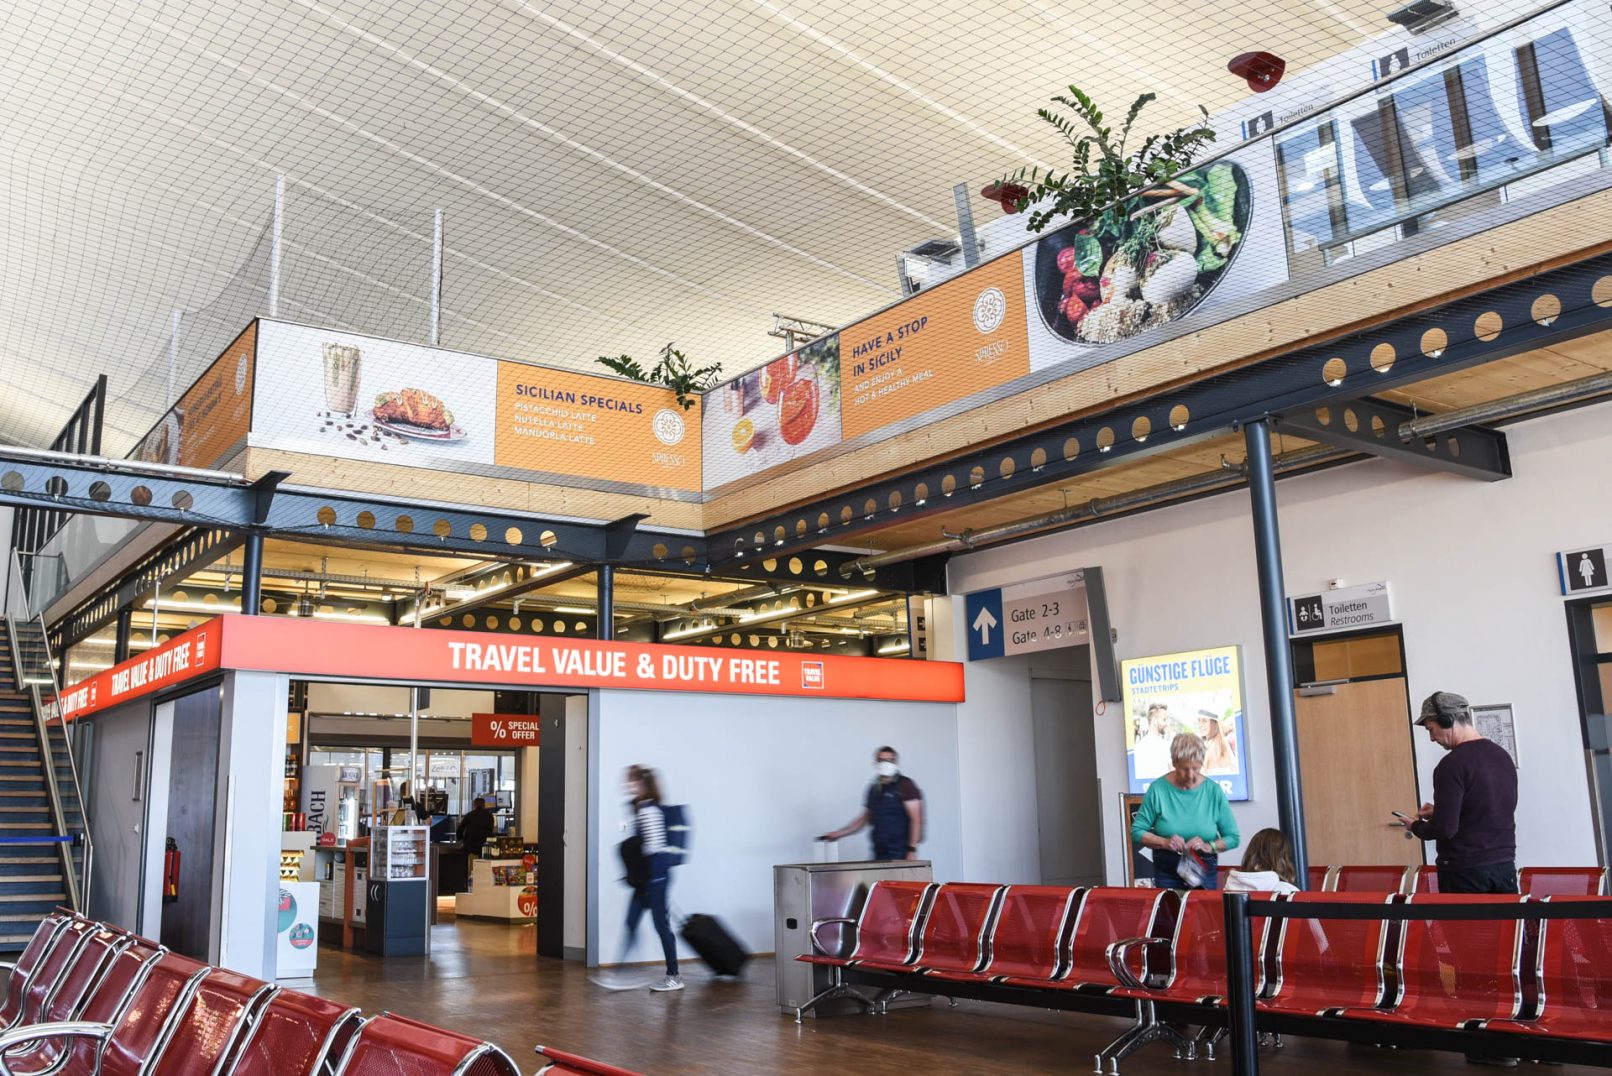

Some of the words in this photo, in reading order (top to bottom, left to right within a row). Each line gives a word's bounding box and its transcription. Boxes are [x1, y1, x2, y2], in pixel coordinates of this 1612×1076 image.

[852, 336, 882, 358] HAVE
[887, 332, 894, 344] A
[897, 316, 928, 339] STOP
[853, 363, 865, 377] IN
[869, 347, 903, 371] SICILY
[854, 380, 870, 393] AND
[871, 372, 896, 386] ENJOY
[878, 379, 910, 398] HEALTHY
[911, 369, 934, 383] MEAL
[516, 384, 576, 404] SICILIAN
[580, 394, 643, 414] SPECIALS
[515, 414, 555, 428] NUTELLA
[557, 421, 585, 432] LATTE
[571, 412, 597, 423] LATTE
[569, 434, 596, 445] LATTE
[1011, 607, 1036, 623] Gate
[1041, 602, 1060, 618] 2-3
[1329, 601, 1368, 615] Toiletten
[1330, 612, 1374, 626] Restrooms
[1012, 629, 1037, 645] Gate
[1043, 624, 1062, 639] 4-8
[111, 668, 130, 696] TRAVEL
[130, 659, 148, 689] VALUE
[149, 658, 155, 682] &
[155, 649, 173, 680] DUTY
[172, 641, 191, 674] FREE
[448, 641, 546, 673] TRAVEL
[552, 648, 627, 677] VALUE
[636, 653, 656, 678] &
[662, 654, 723, 682] DUTY
[729, 658, 780, 684] FREE
[1129, 661, 1188, 685] GÜNSTIGE
[1191, 654, 1231, 678] FLÜGE
[490, 720, 507, 739] %
[508, 721, 540, 731] SPECIAL
[512, 731, 535, 740] OFFER
